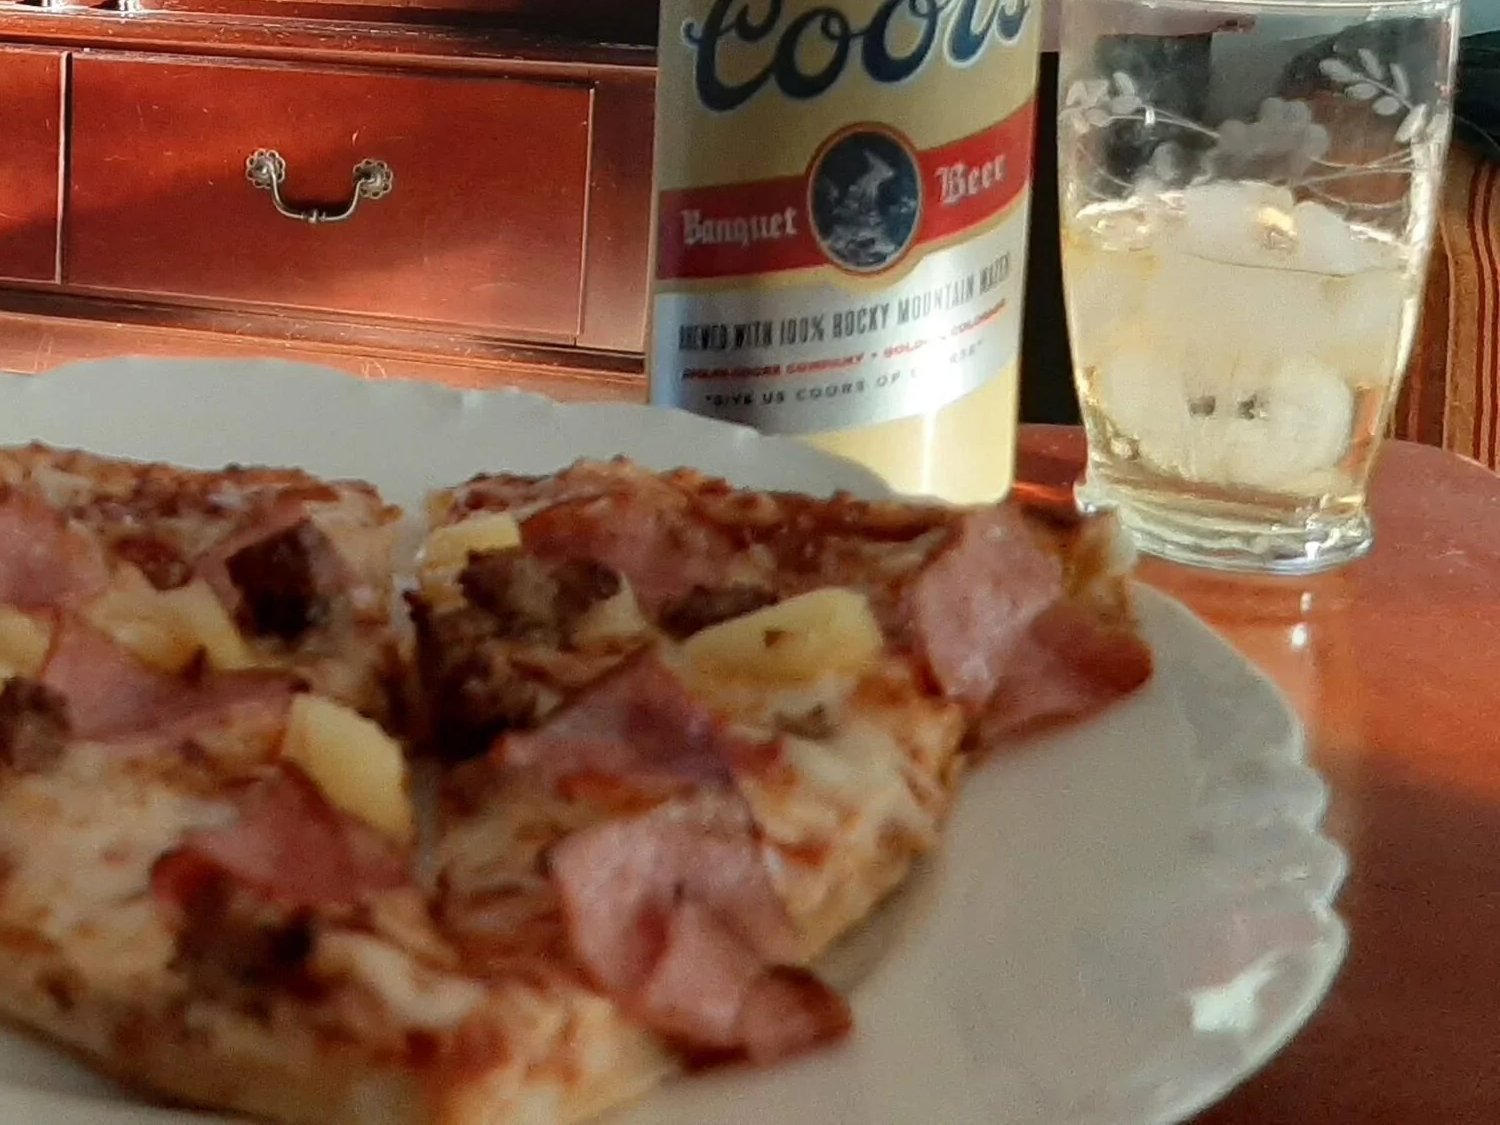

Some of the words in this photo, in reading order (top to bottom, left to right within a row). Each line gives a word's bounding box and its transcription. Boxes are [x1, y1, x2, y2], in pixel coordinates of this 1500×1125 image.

[679, 205, 797, 247] Banquet
[934, 153, 1007, 208] Beer
[733, 318, 773, 349] WITH
[779, 312, 825, 345] 100%
[832, 302, 890, 338] ROCKY
[896, 273, 975, 325] MOUNTAIN
[796, 379, 865, 402] COORS
